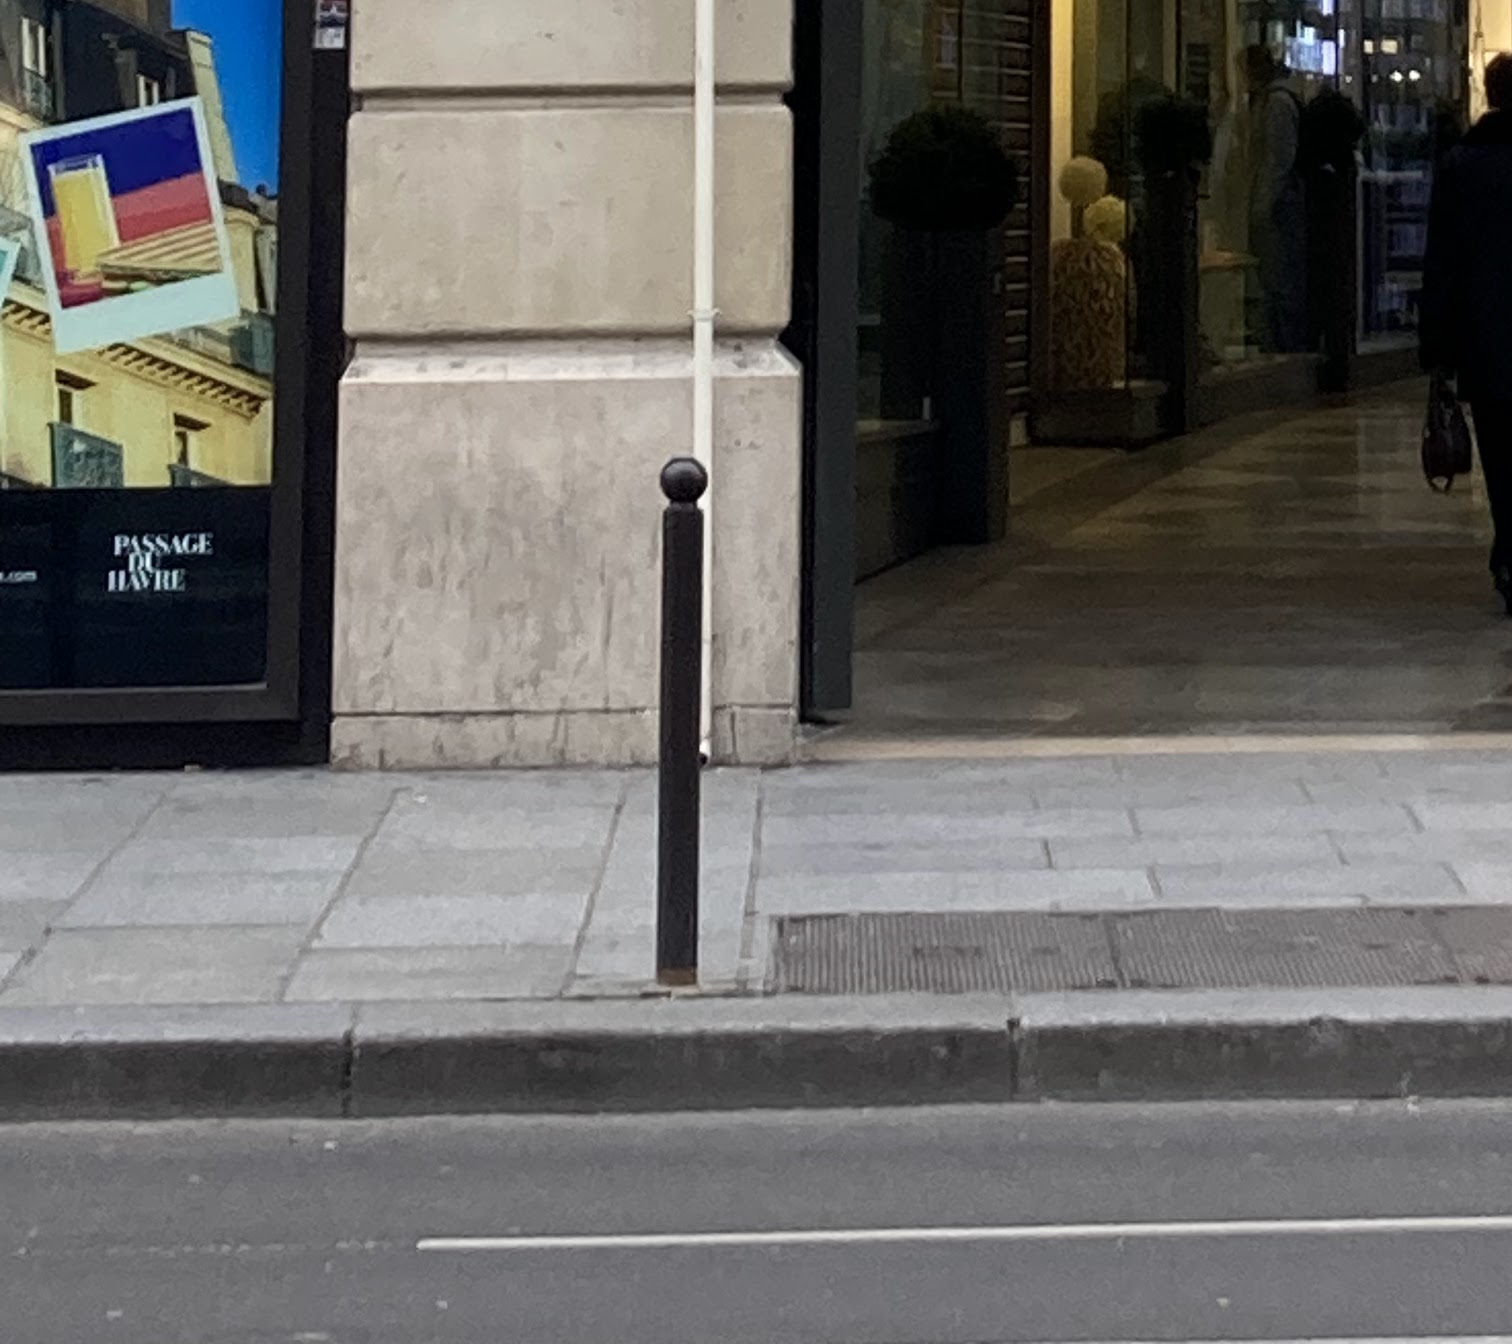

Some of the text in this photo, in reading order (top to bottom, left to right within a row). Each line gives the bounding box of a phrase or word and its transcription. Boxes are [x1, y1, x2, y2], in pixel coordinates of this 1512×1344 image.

[113, 533, 213, 556] PASSAGE
[128, 550, 161, 574] DU
[107, 568, 186, 592] HAVRE
